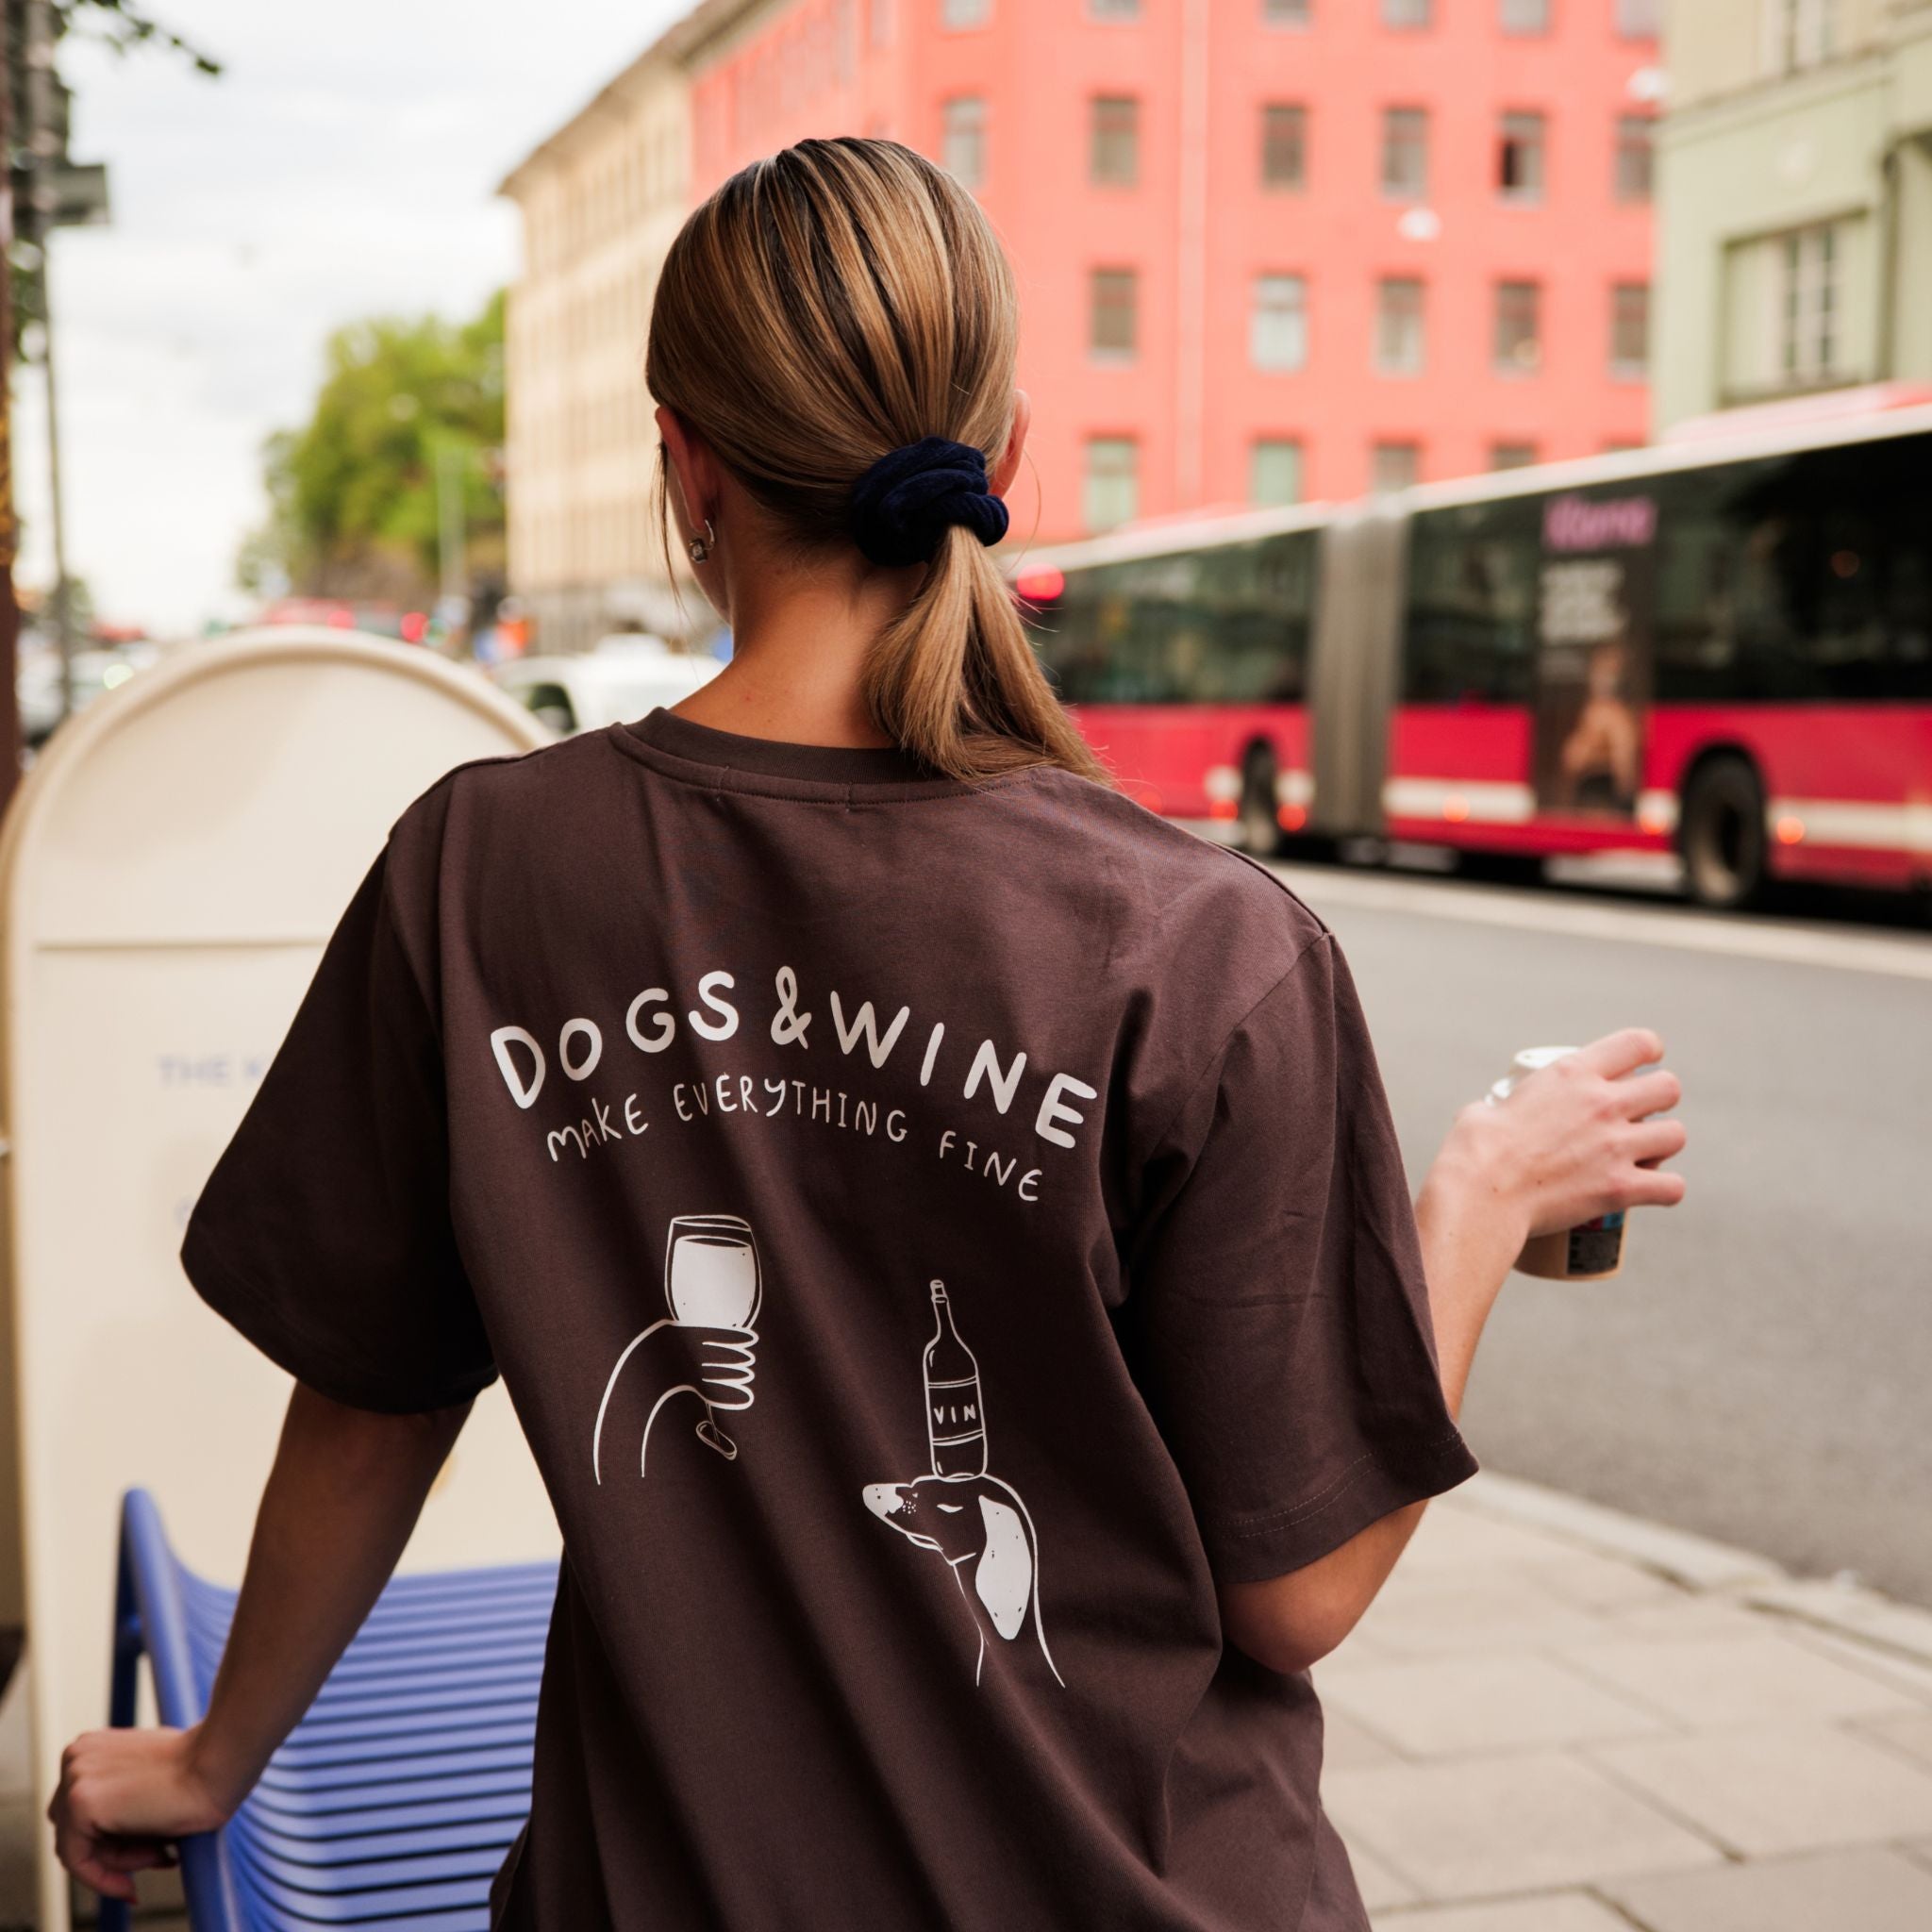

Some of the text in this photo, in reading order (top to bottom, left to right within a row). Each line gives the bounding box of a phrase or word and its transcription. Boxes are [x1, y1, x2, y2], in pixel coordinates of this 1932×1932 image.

[490, 970, 740, 1109] DOGS
[830, 990, 1098, 1149] WINE
[547, 1073, 1042, 1202] MAKE EVERYTHING FINE
[933, 1404, 977, 1425] VIN
